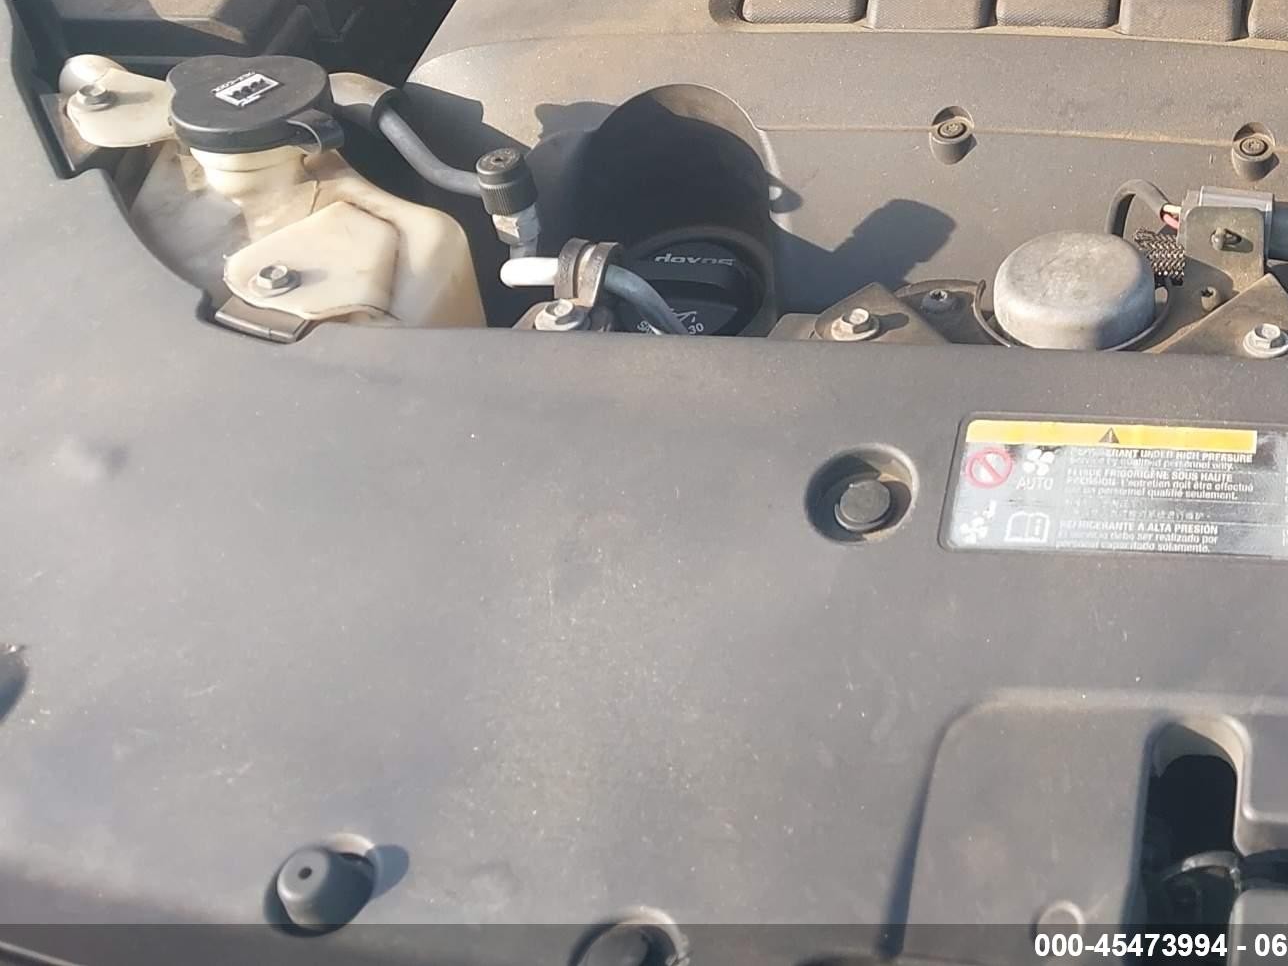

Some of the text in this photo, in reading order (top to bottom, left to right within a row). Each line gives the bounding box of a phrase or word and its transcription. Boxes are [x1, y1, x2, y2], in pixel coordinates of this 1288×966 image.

[1175, 450, 1200, 461] HIGH
[1201, 452, 1253, 464] PRESSURE
[1016, 476, 1054, 491] AUTO
[1171, 471, 1198, 481] SOUS
[1200, 472, 1233, 483] HAUTE
[1147, 522, 1172, 533] ALTA
[1155, 533, 1200, 543] realizado
[1202, 536, 1219, 547] por
